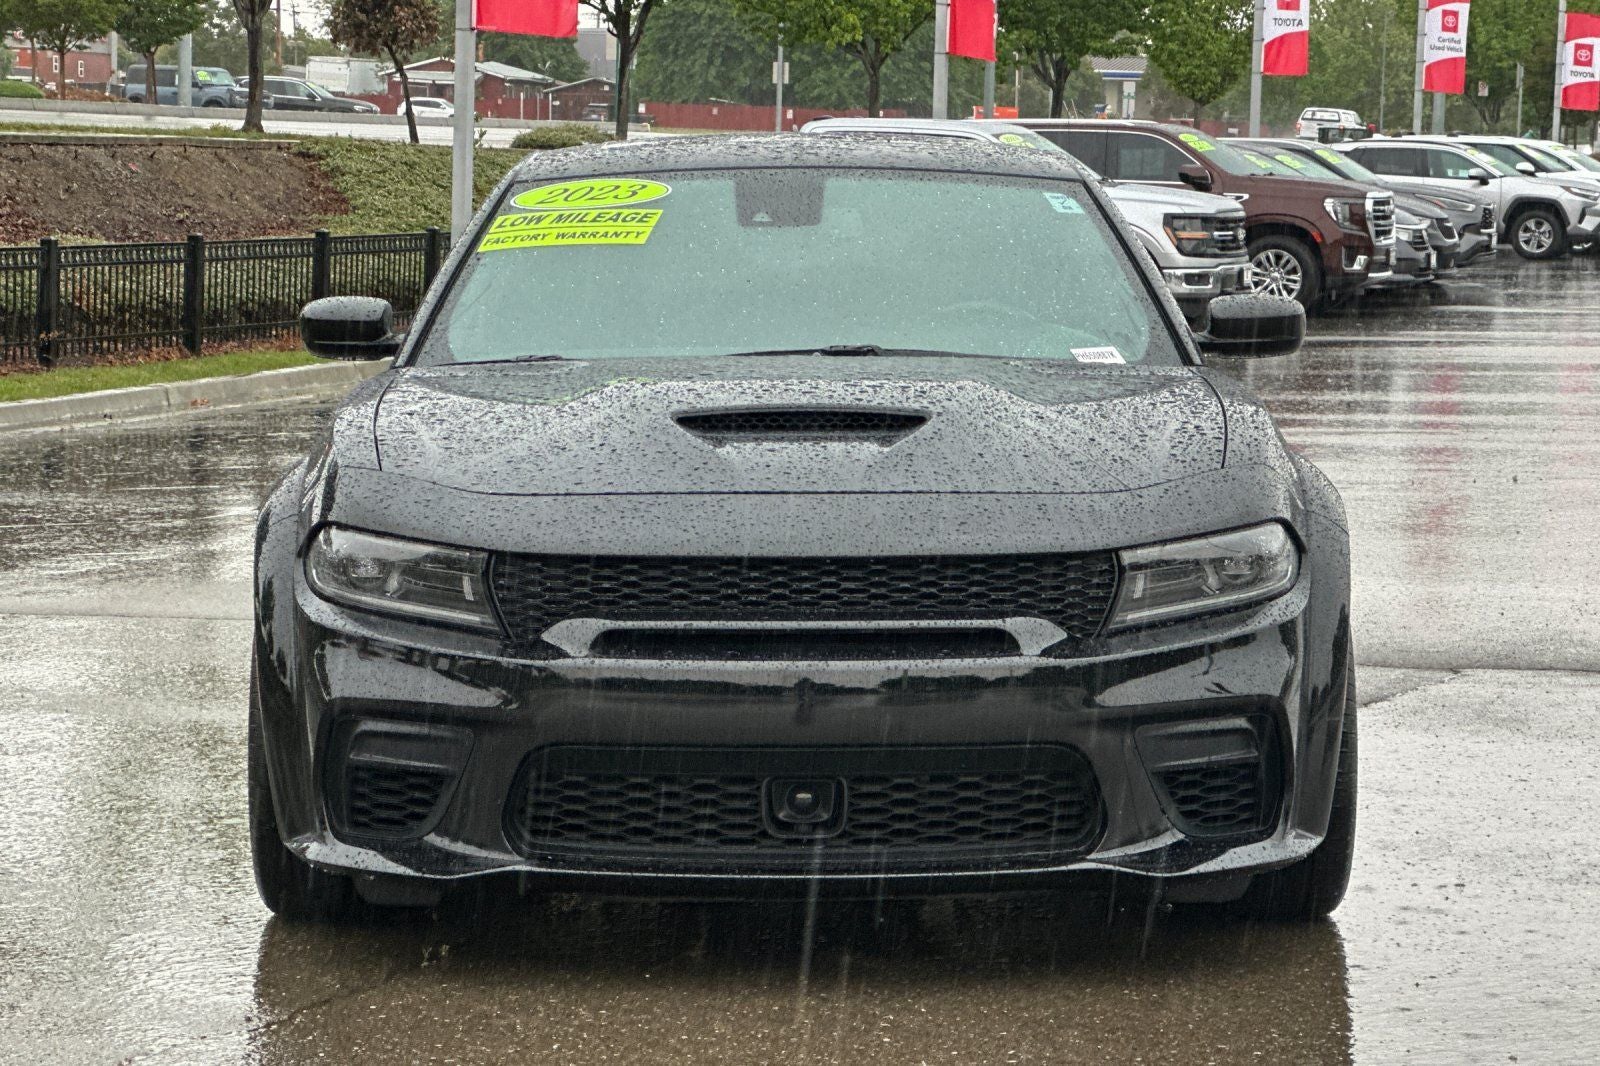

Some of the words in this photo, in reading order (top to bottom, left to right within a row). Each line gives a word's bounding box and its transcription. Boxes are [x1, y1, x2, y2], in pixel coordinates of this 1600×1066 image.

[1273, 18, 1304, 27] TOYOTA
[1570, 70, 1595, 78] TOYOTA
[535, 183, 648, 205] 2023
[495, 214, 548, 230] LOW
[551, 212, 657, 226] MILEAGE
[481, 233, 548, 246] FACTORY
[555, 231, 643, 241] WARRANTY
